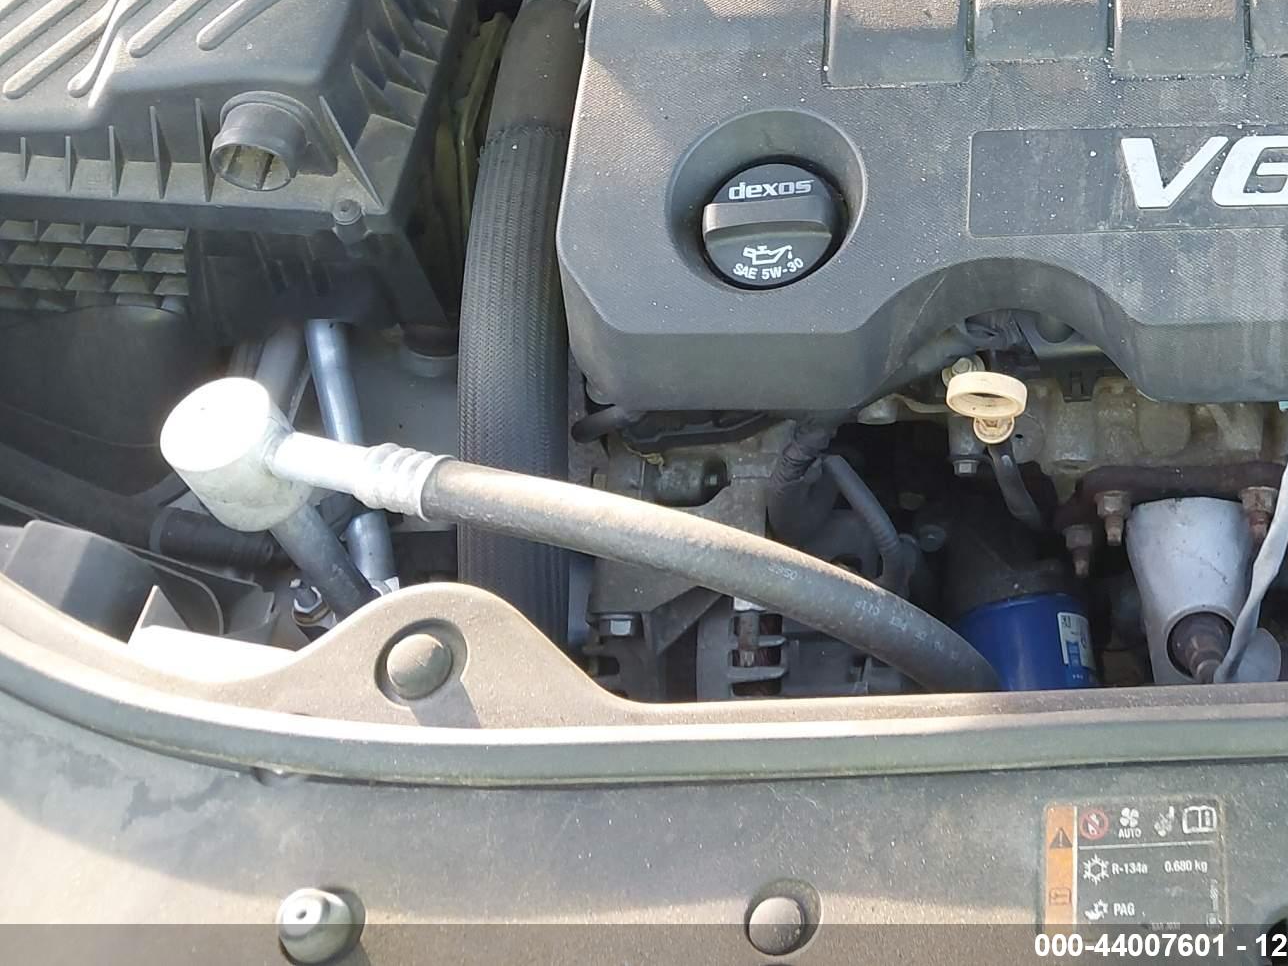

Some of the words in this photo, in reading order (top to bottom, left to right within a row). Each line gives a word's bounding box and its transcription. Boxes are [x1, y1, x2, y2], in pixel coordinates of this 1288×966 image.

[728, 180, 813, 200] dexos
[733, 263, 758, 280] SAE
[761, 257, 804, 280] 5W-30
[1118, 828, 1142, 839] AUTO
[1111, 862, 1148, 875] R-134a
[1194, 859, 1208, 873] kg
[1113, 902, 1135, 917] PAG
